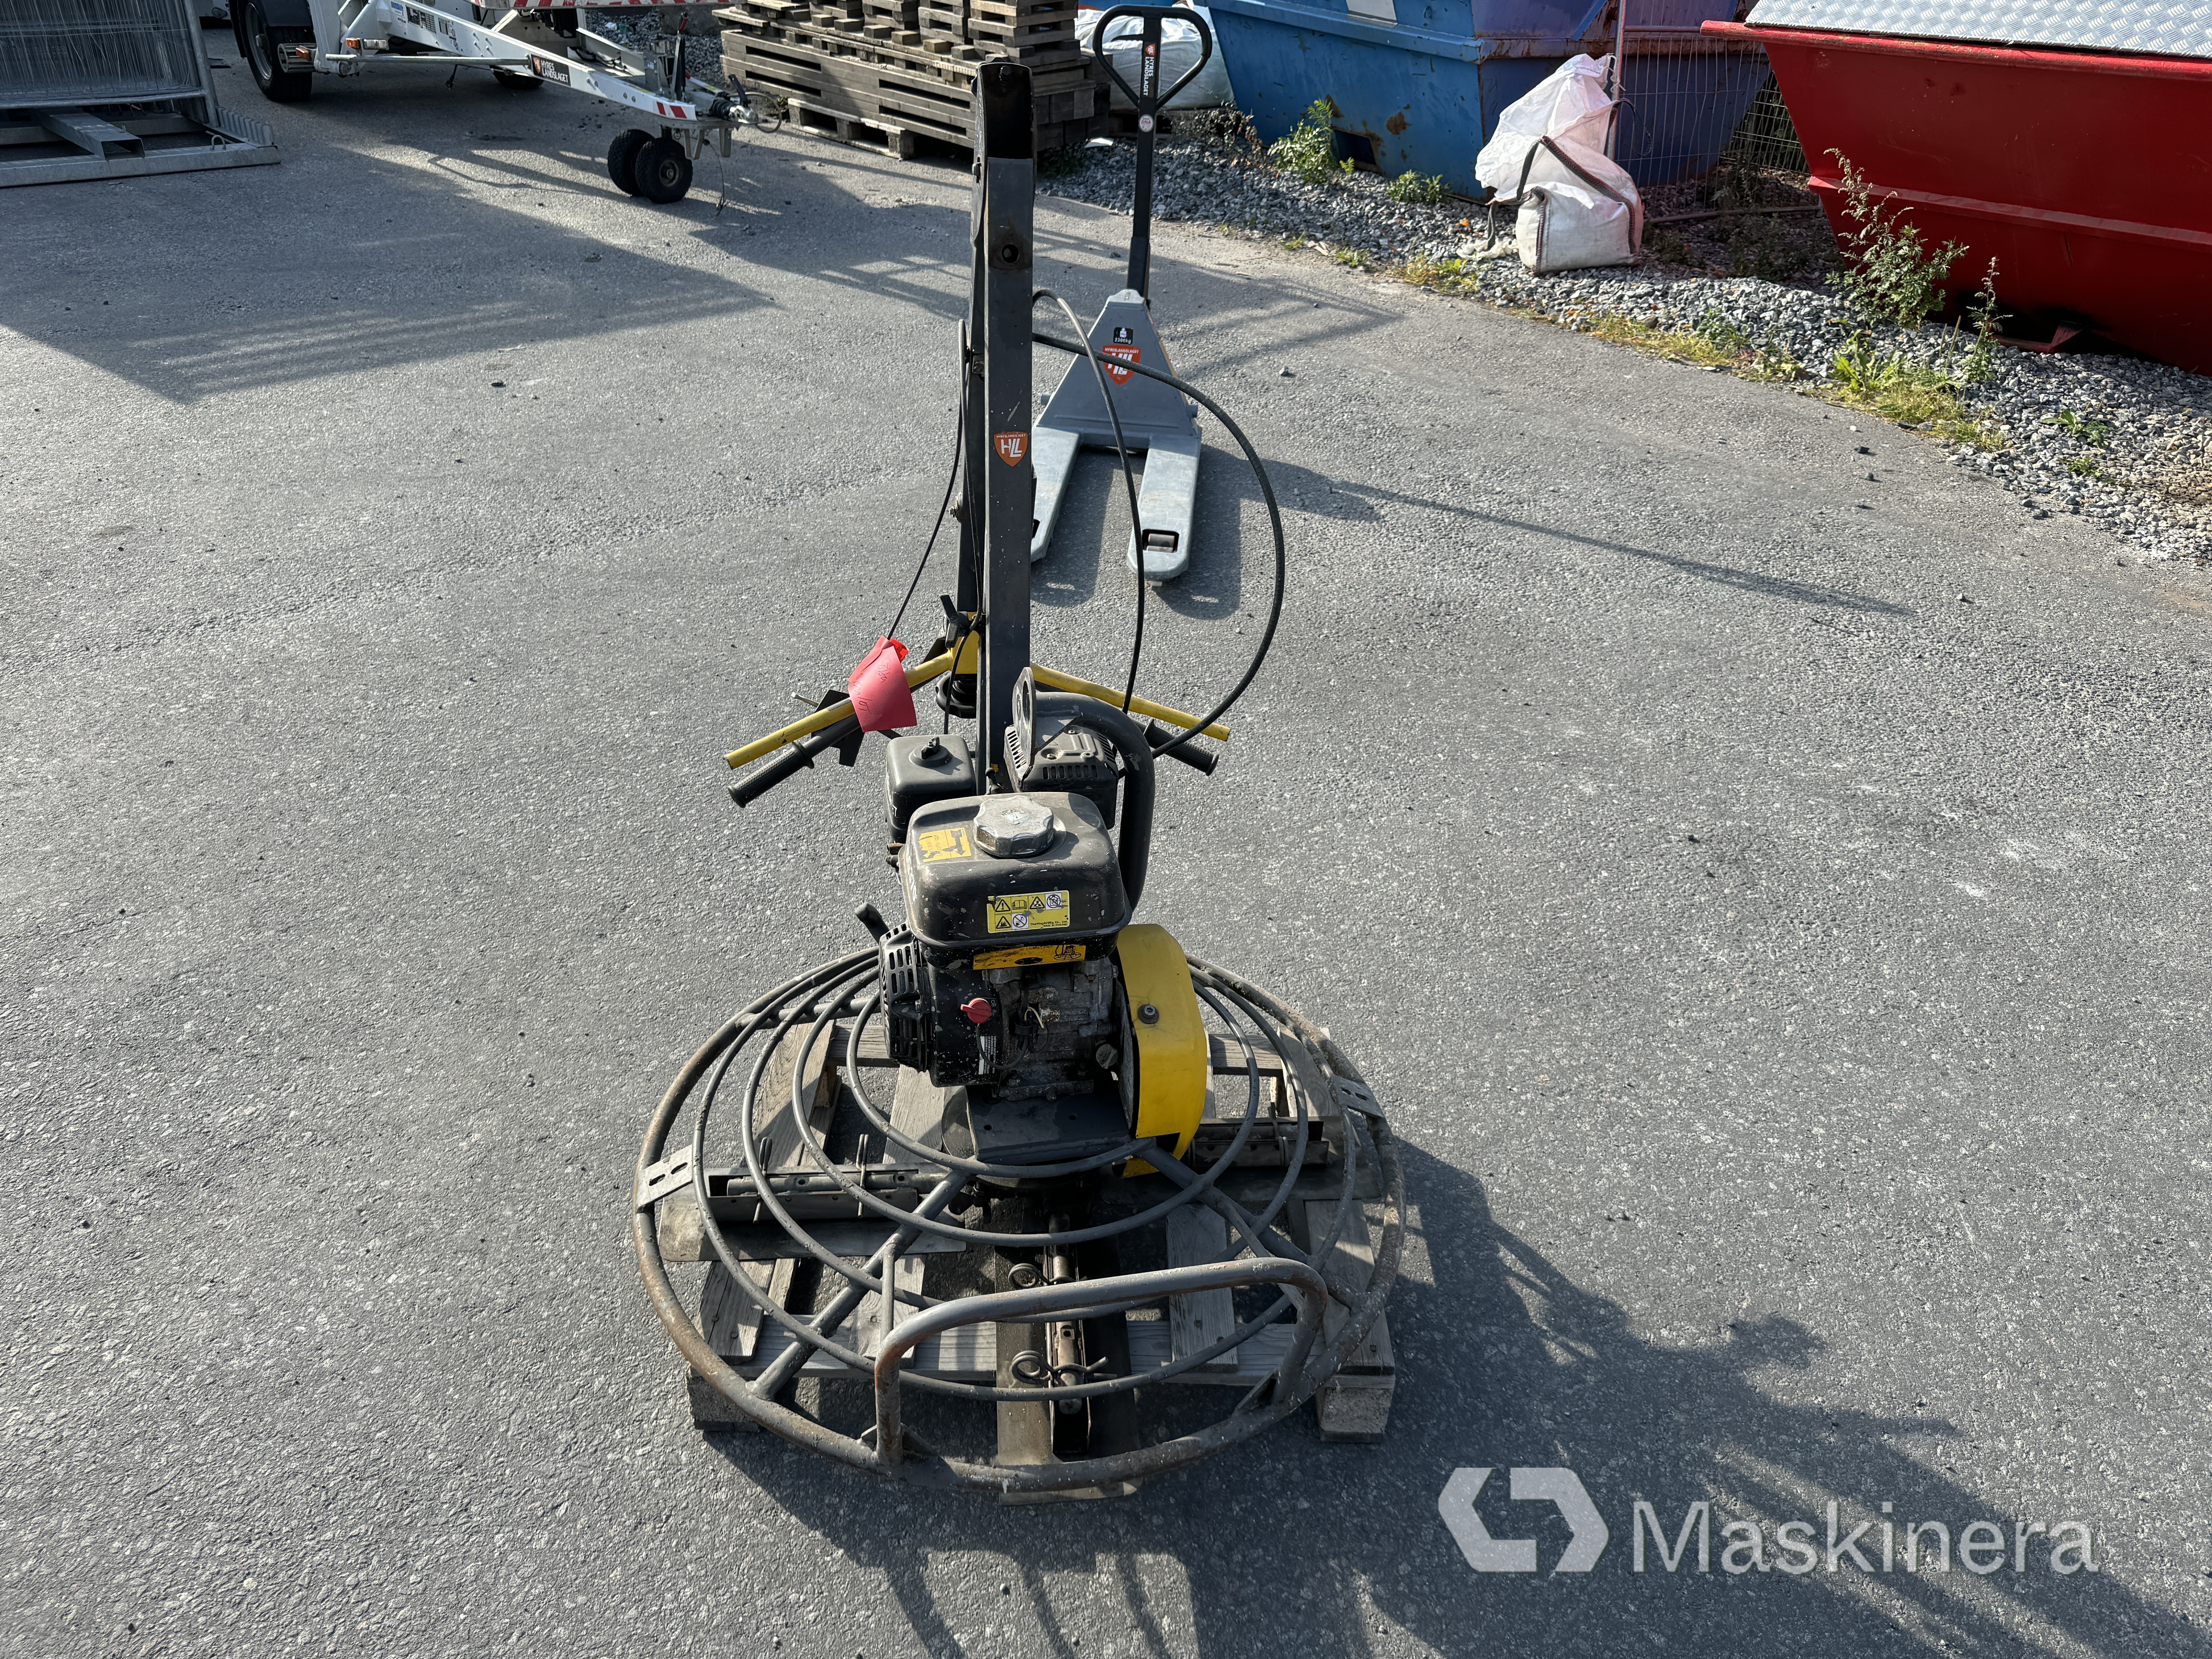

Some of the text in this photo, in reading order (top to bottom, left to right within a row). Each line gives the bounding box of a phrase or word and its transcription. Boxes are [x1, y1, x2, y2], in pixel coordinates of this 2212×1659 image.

[541, 60, 555, 71] HYRES
[542, 68, 568, 83] LANDSLAGET
[1001, 438, 1022, 457] HLL
